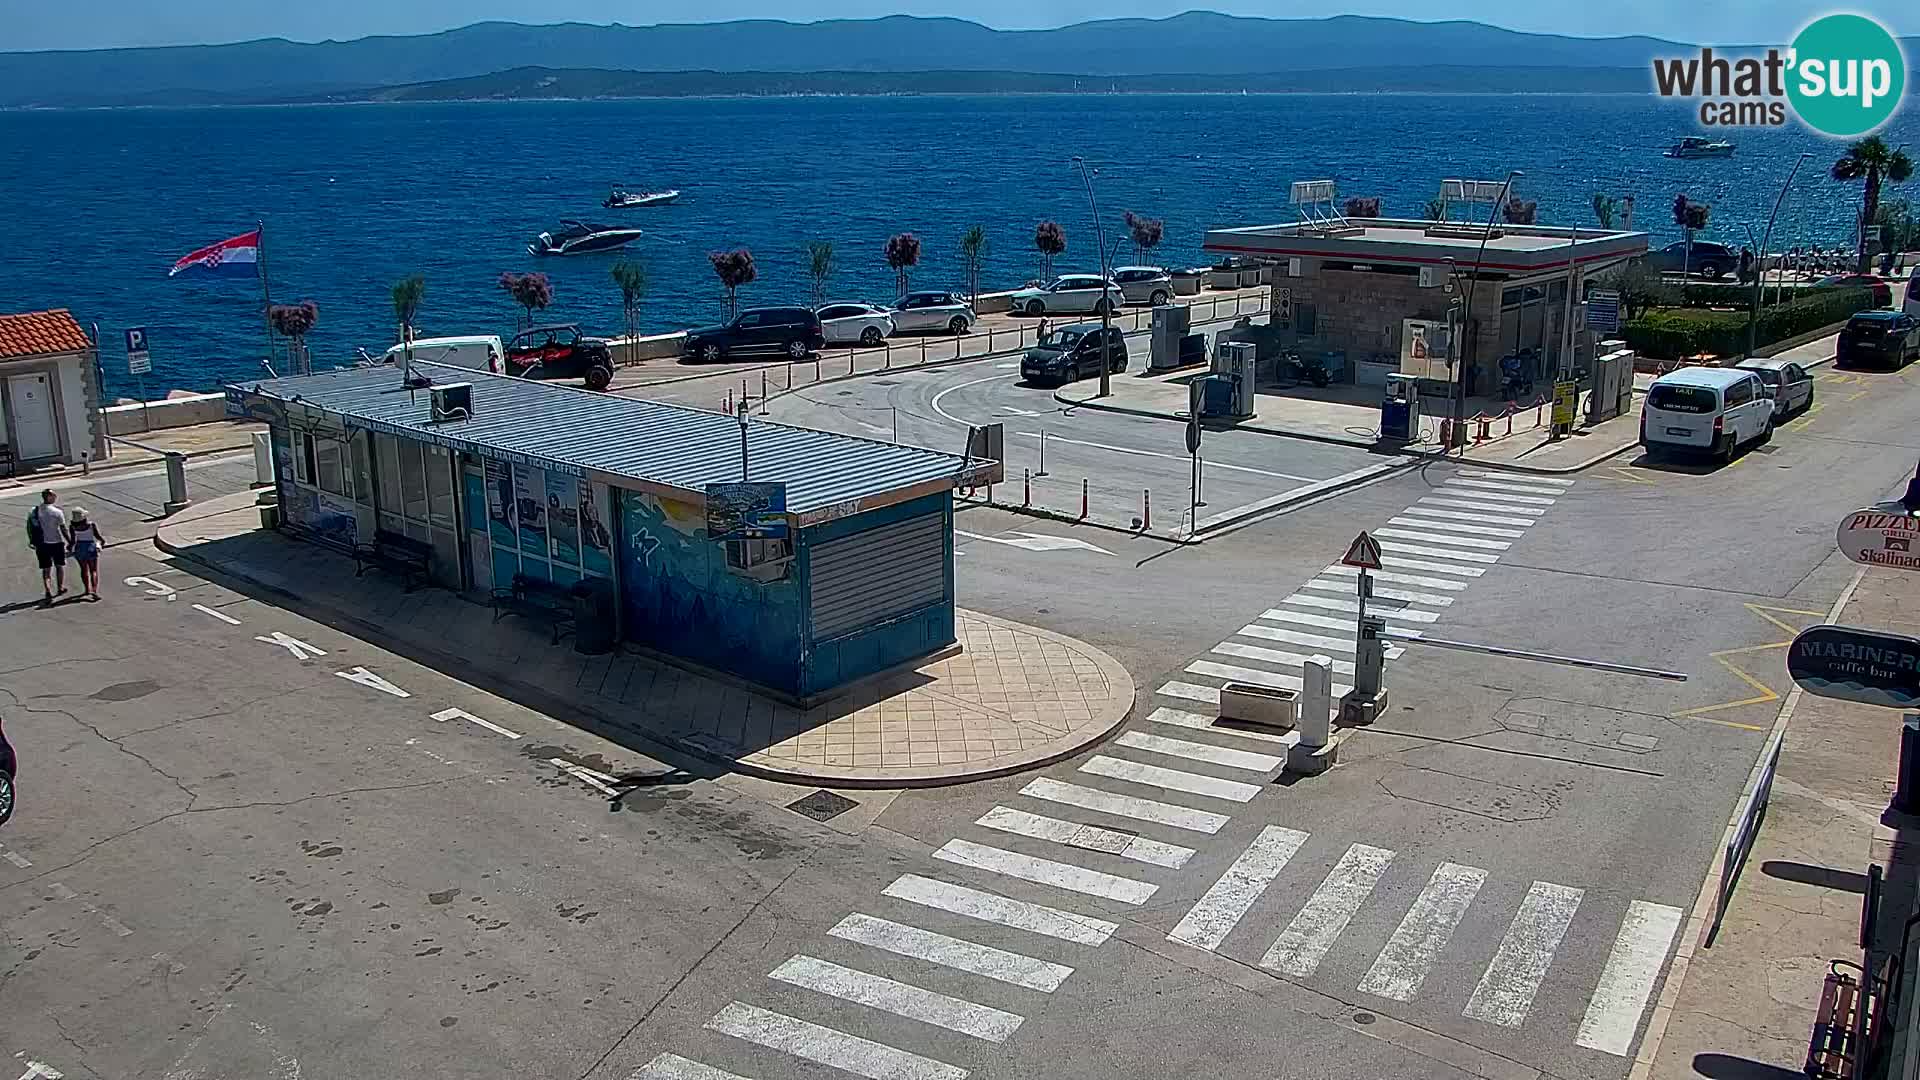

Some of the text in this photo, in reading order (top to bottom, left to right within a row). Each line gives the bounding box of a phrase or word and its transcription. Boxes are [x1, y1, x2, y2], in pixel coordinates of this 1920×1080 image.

[130, 331, 142, 348] P
[478, 445, 492, 457] BUS
[493, 448, 526, 463] STATION
[527, 456, 553, 470] TICKET
[555, 461, 582, 476] OFFICE
[1848, 514, 1920, 532] PIZZE
[1882, 530, 1915, 539] GRILL
[1800, 642, 1920, 671] MARINER
[1829, 661, 1896, 679] caffe bar
